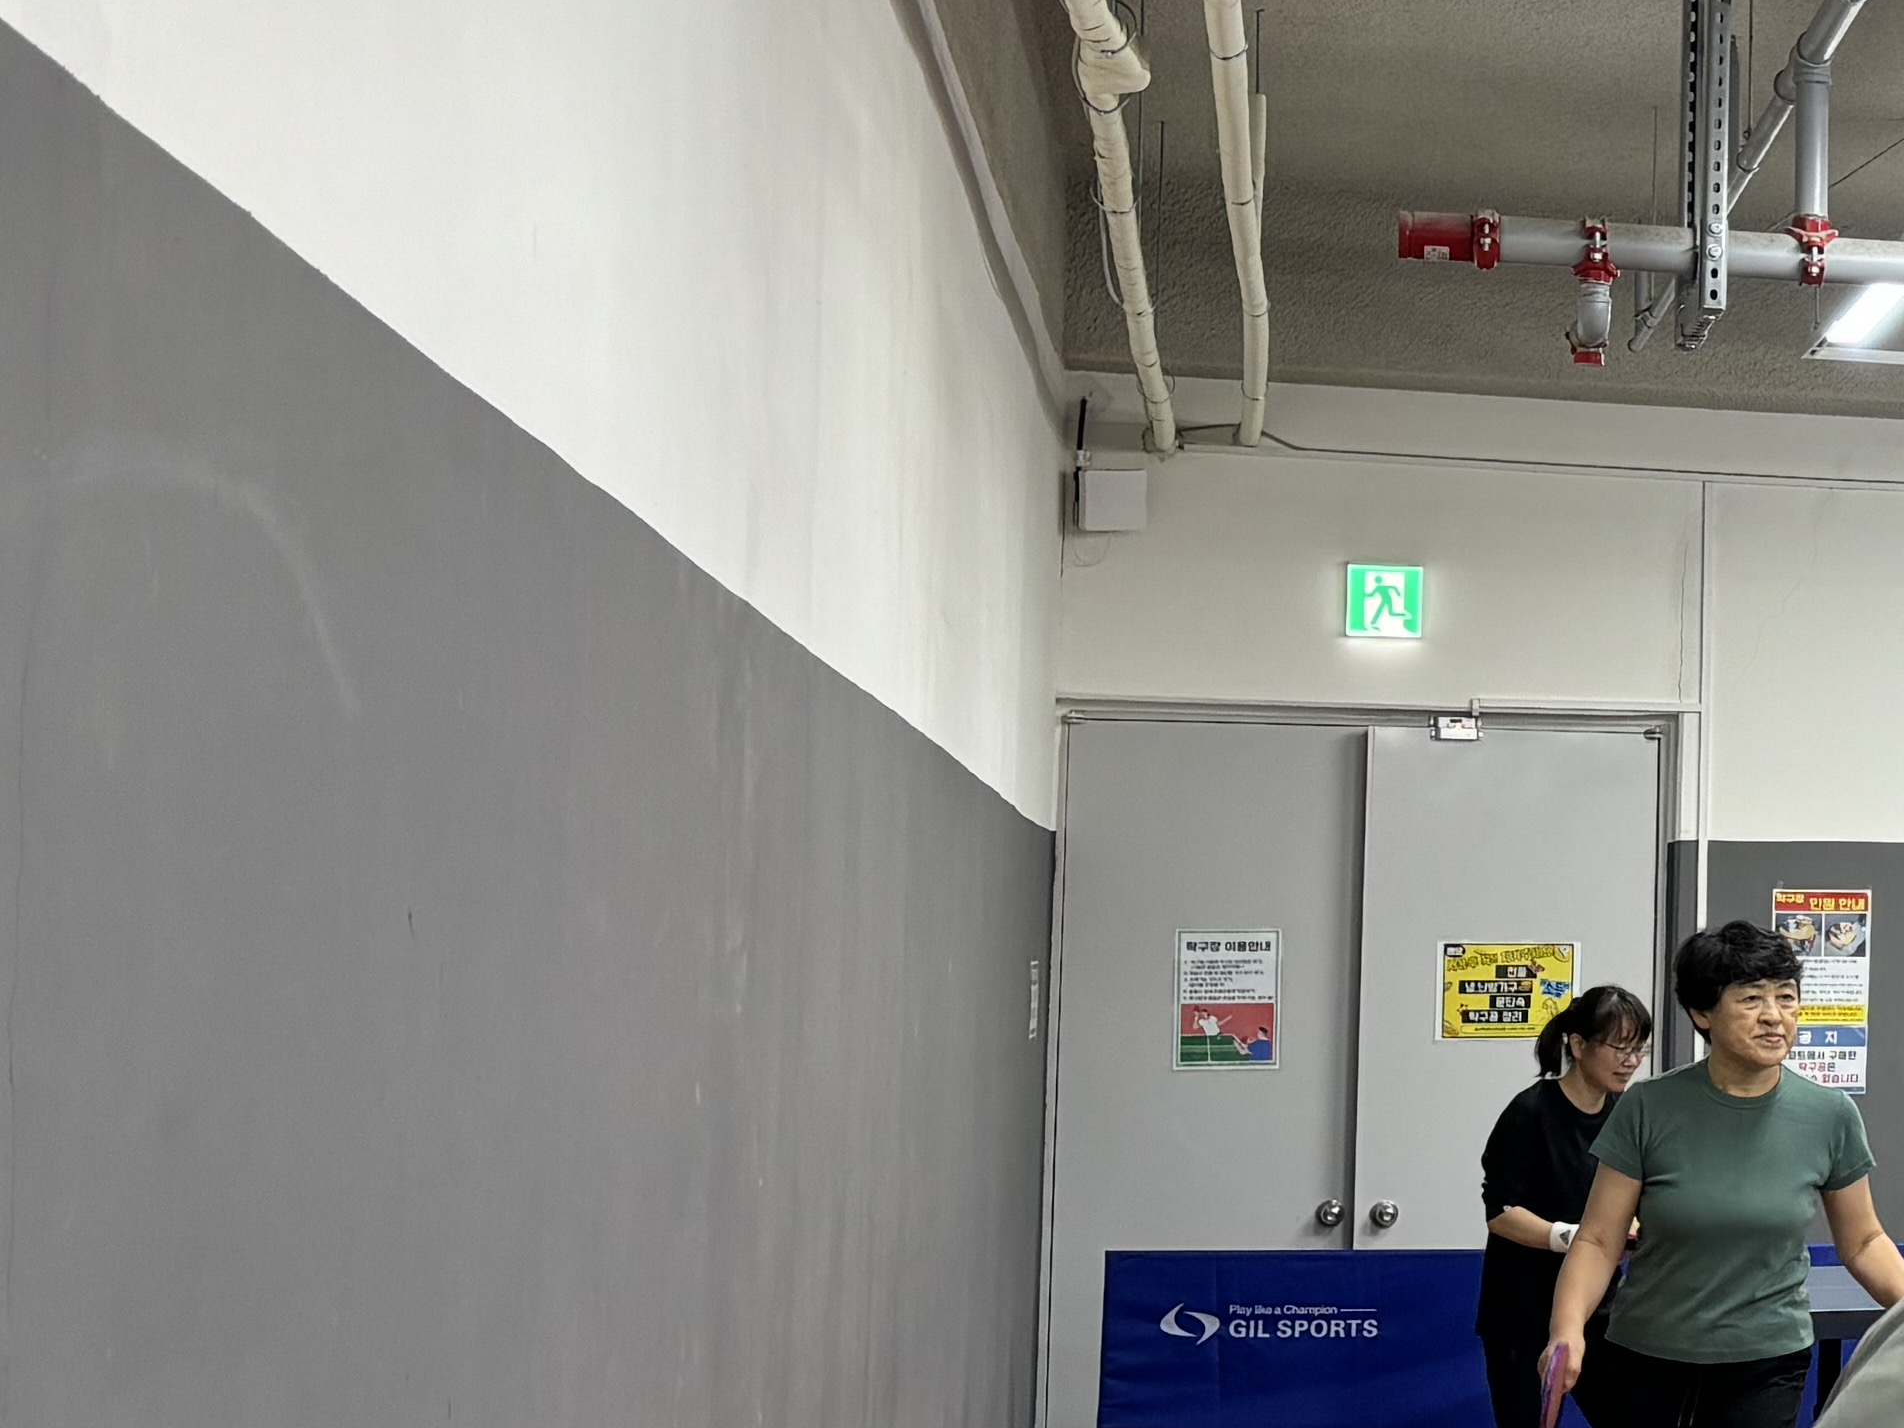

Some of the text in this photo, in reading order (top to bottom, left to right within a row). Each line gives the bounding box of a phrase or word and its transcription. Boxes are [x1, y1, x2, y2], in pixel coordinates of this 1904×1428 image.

[1186, 941, 1221, 952] 탁구장
[1788, 1051, 1825, 1060] 파트에서
[1229, 1305, 1252, 1316] Play
[1284, 1305, 1338, 1316] Champion
[1229, 1319, 1378, 1338] GIL SPORTS
